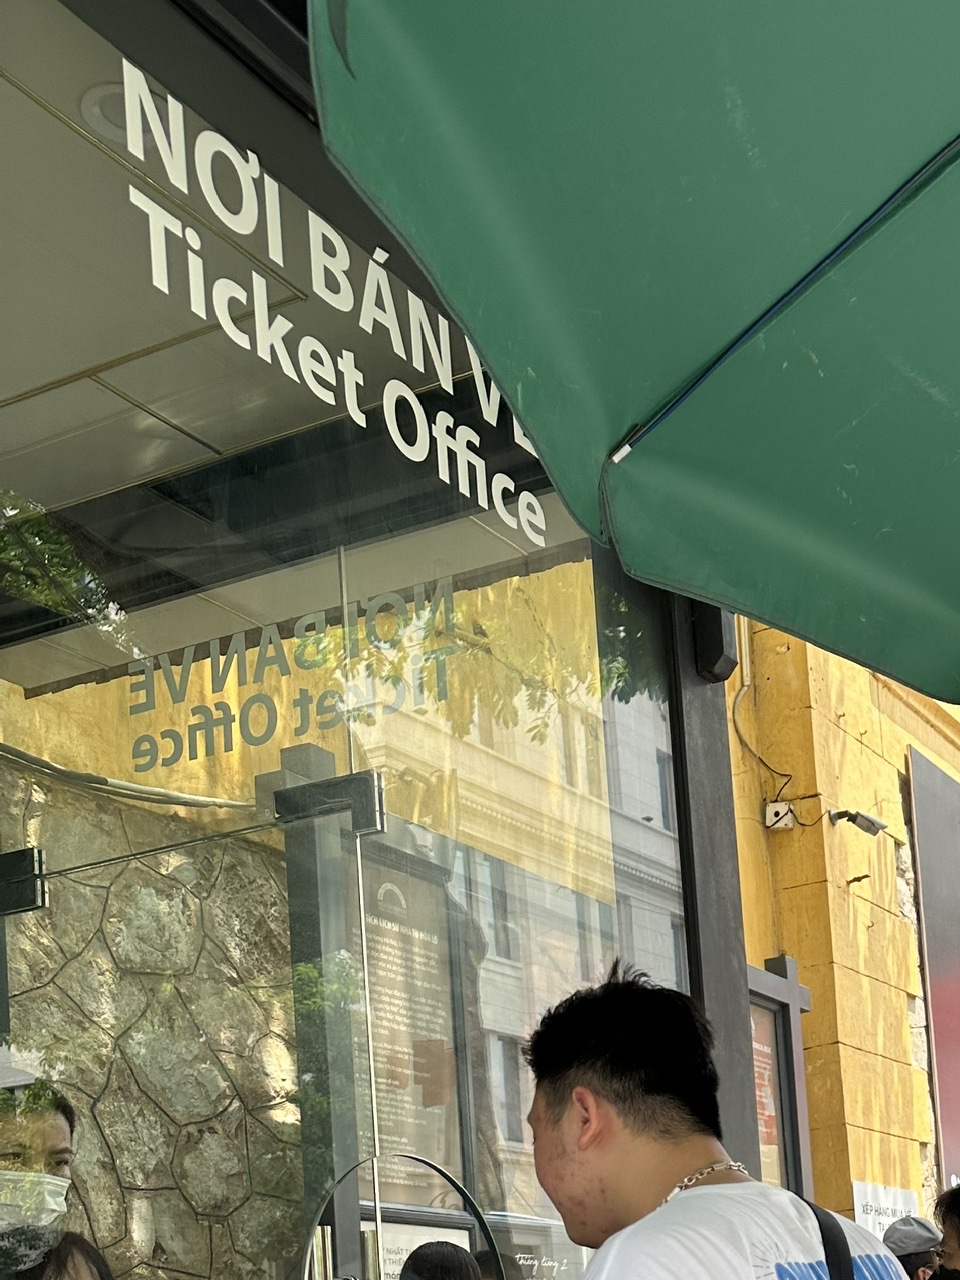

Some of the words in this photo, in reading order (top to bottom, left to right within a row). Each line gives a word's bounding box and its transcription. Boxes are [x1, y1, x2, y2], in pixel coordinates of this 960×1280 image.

[122, 57, 283, 267] NƠI
[308, 209, 454, 395] BÁN
[129, 185, 366, 428] Ticket
[383, 379, 546, 547] Office
[560, 1258, 568, 1270] 2
